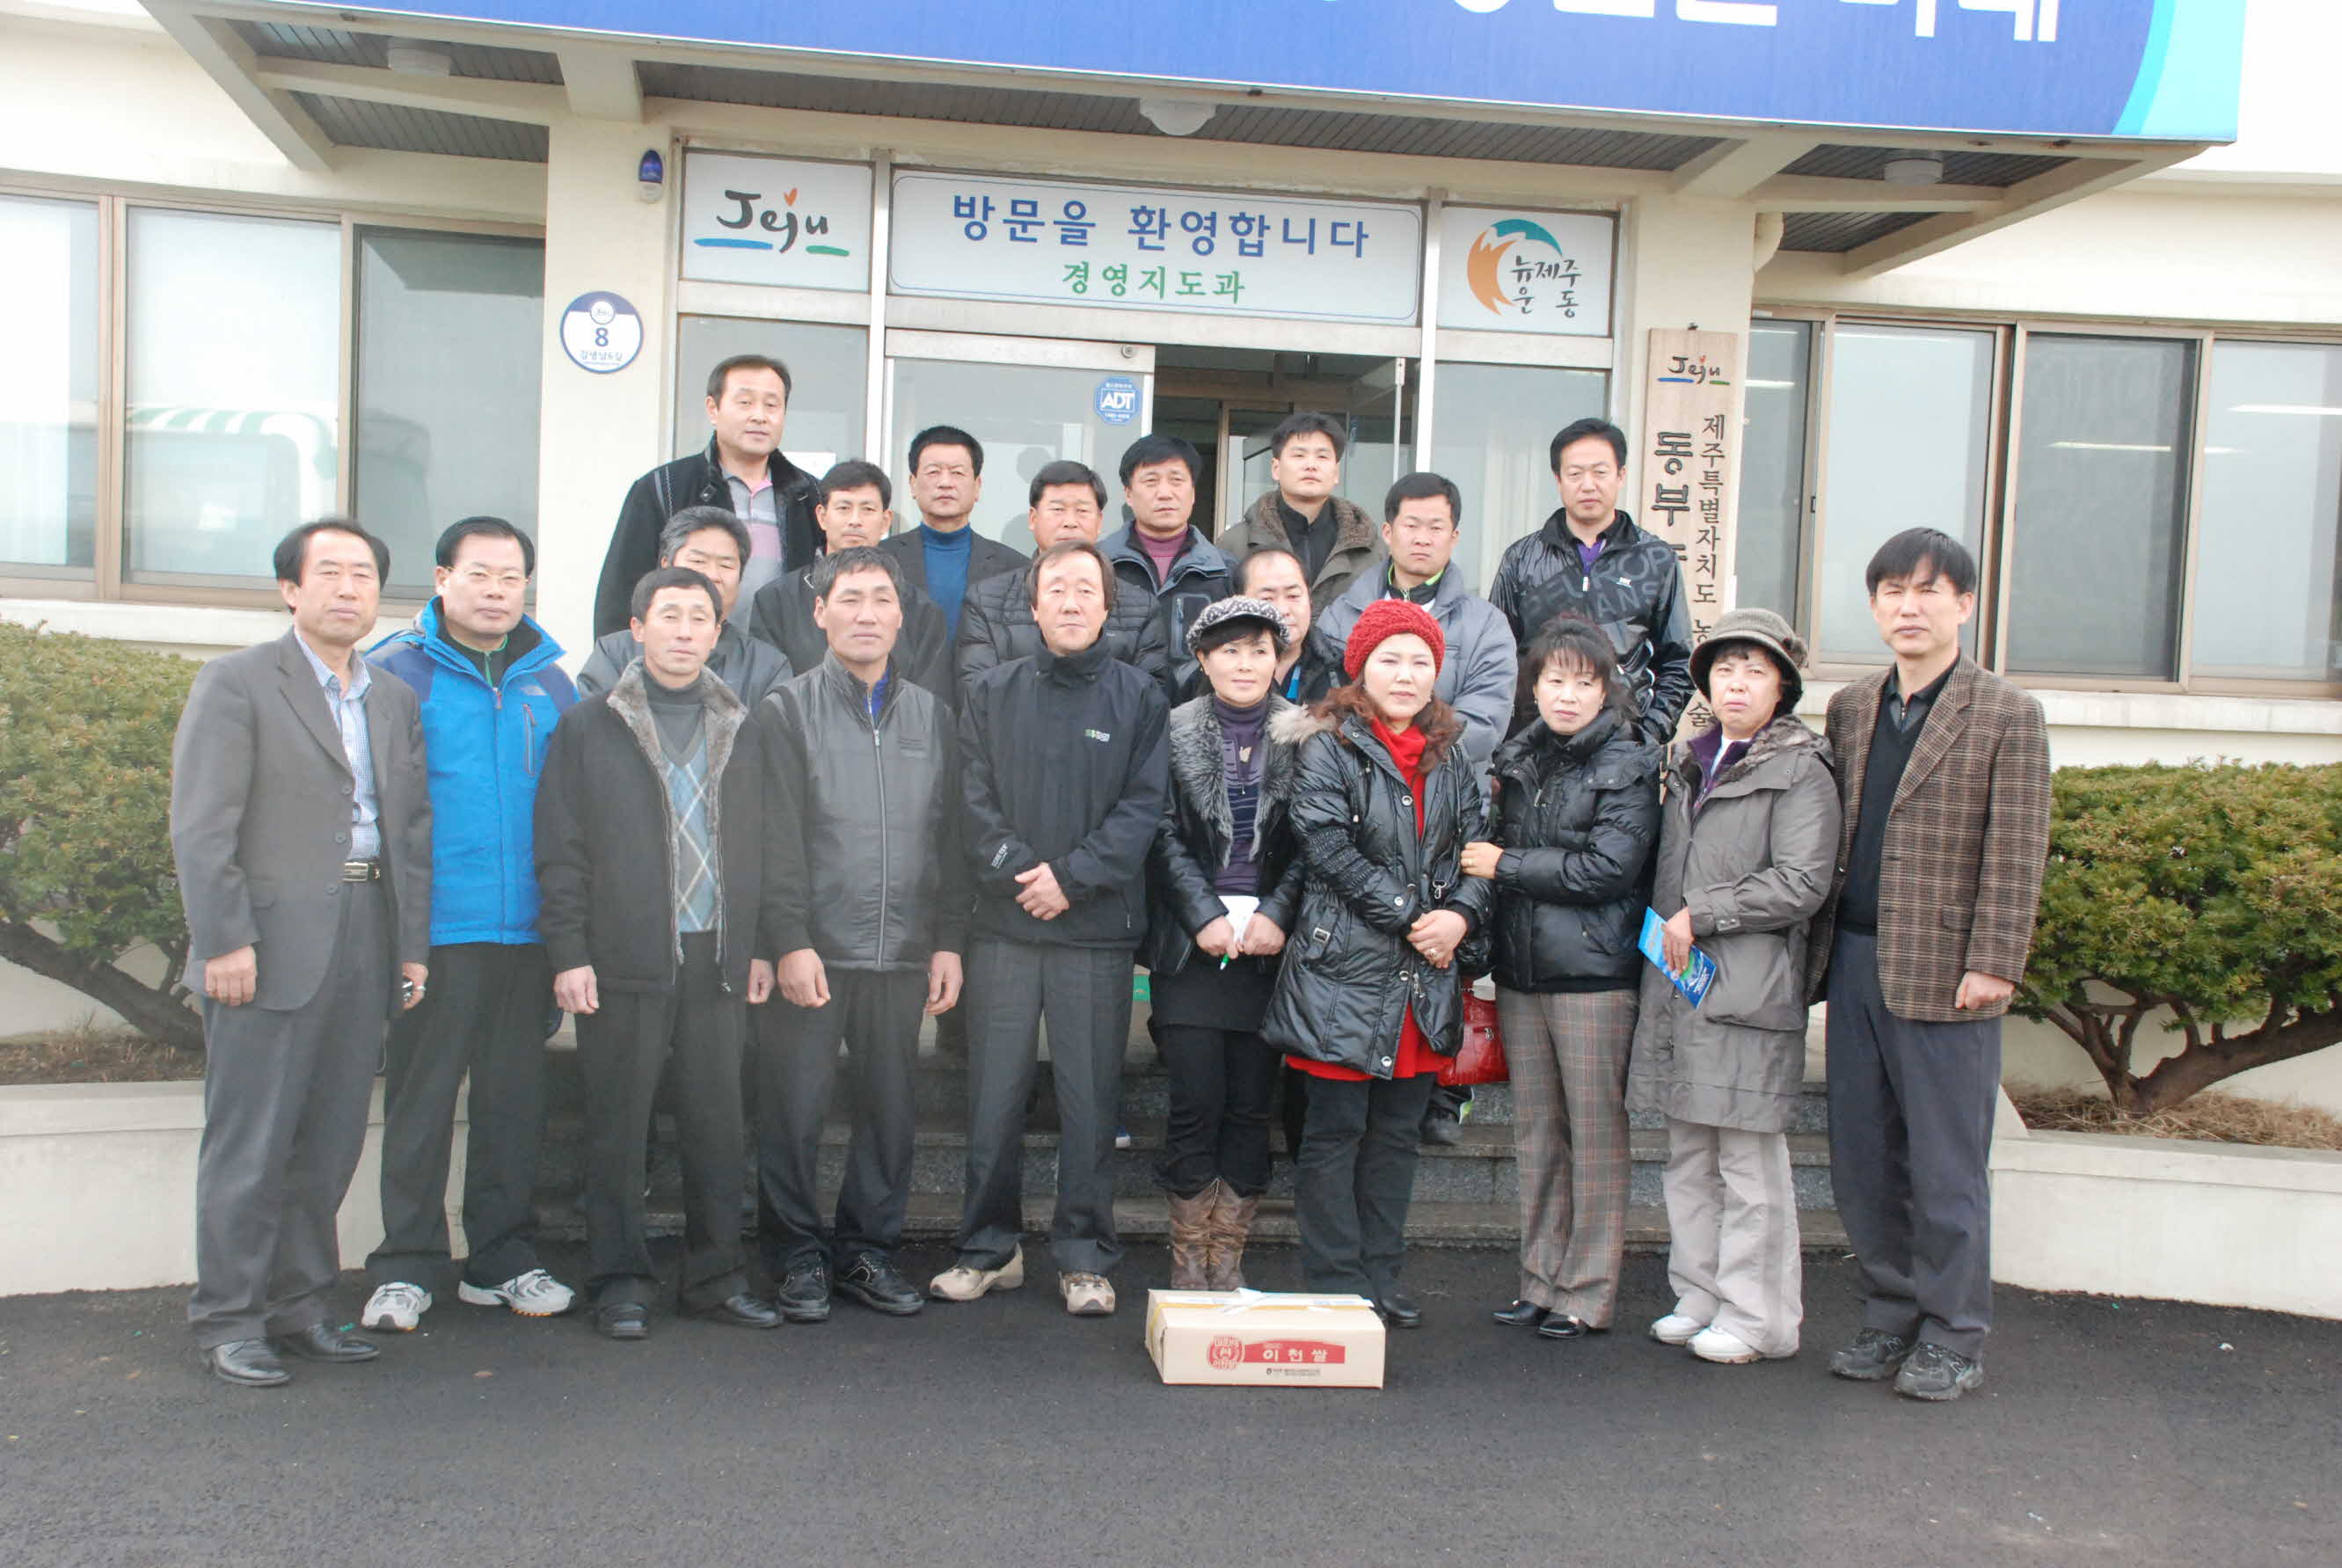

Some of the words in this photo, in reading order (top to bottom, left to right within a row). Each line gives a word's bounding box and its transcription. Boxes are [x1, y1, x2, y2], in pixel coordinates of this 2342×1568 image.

[717, 188, 828, 253] Jeju
[954, 195, 1096, 246] 방문을
[1127, 205, 1369, 258] 환영합니다
[1062, 261, 1245, 303] 경영지도과
[1510, 255, 1582, 288] 뉴제주
[595, 327, 609, 346] 8
[1667, 354, 1720, 383] Jeju
[1100, 392, 1135, 410] ADT
[1692, 413, 1725, 605] 제주특별자치도
